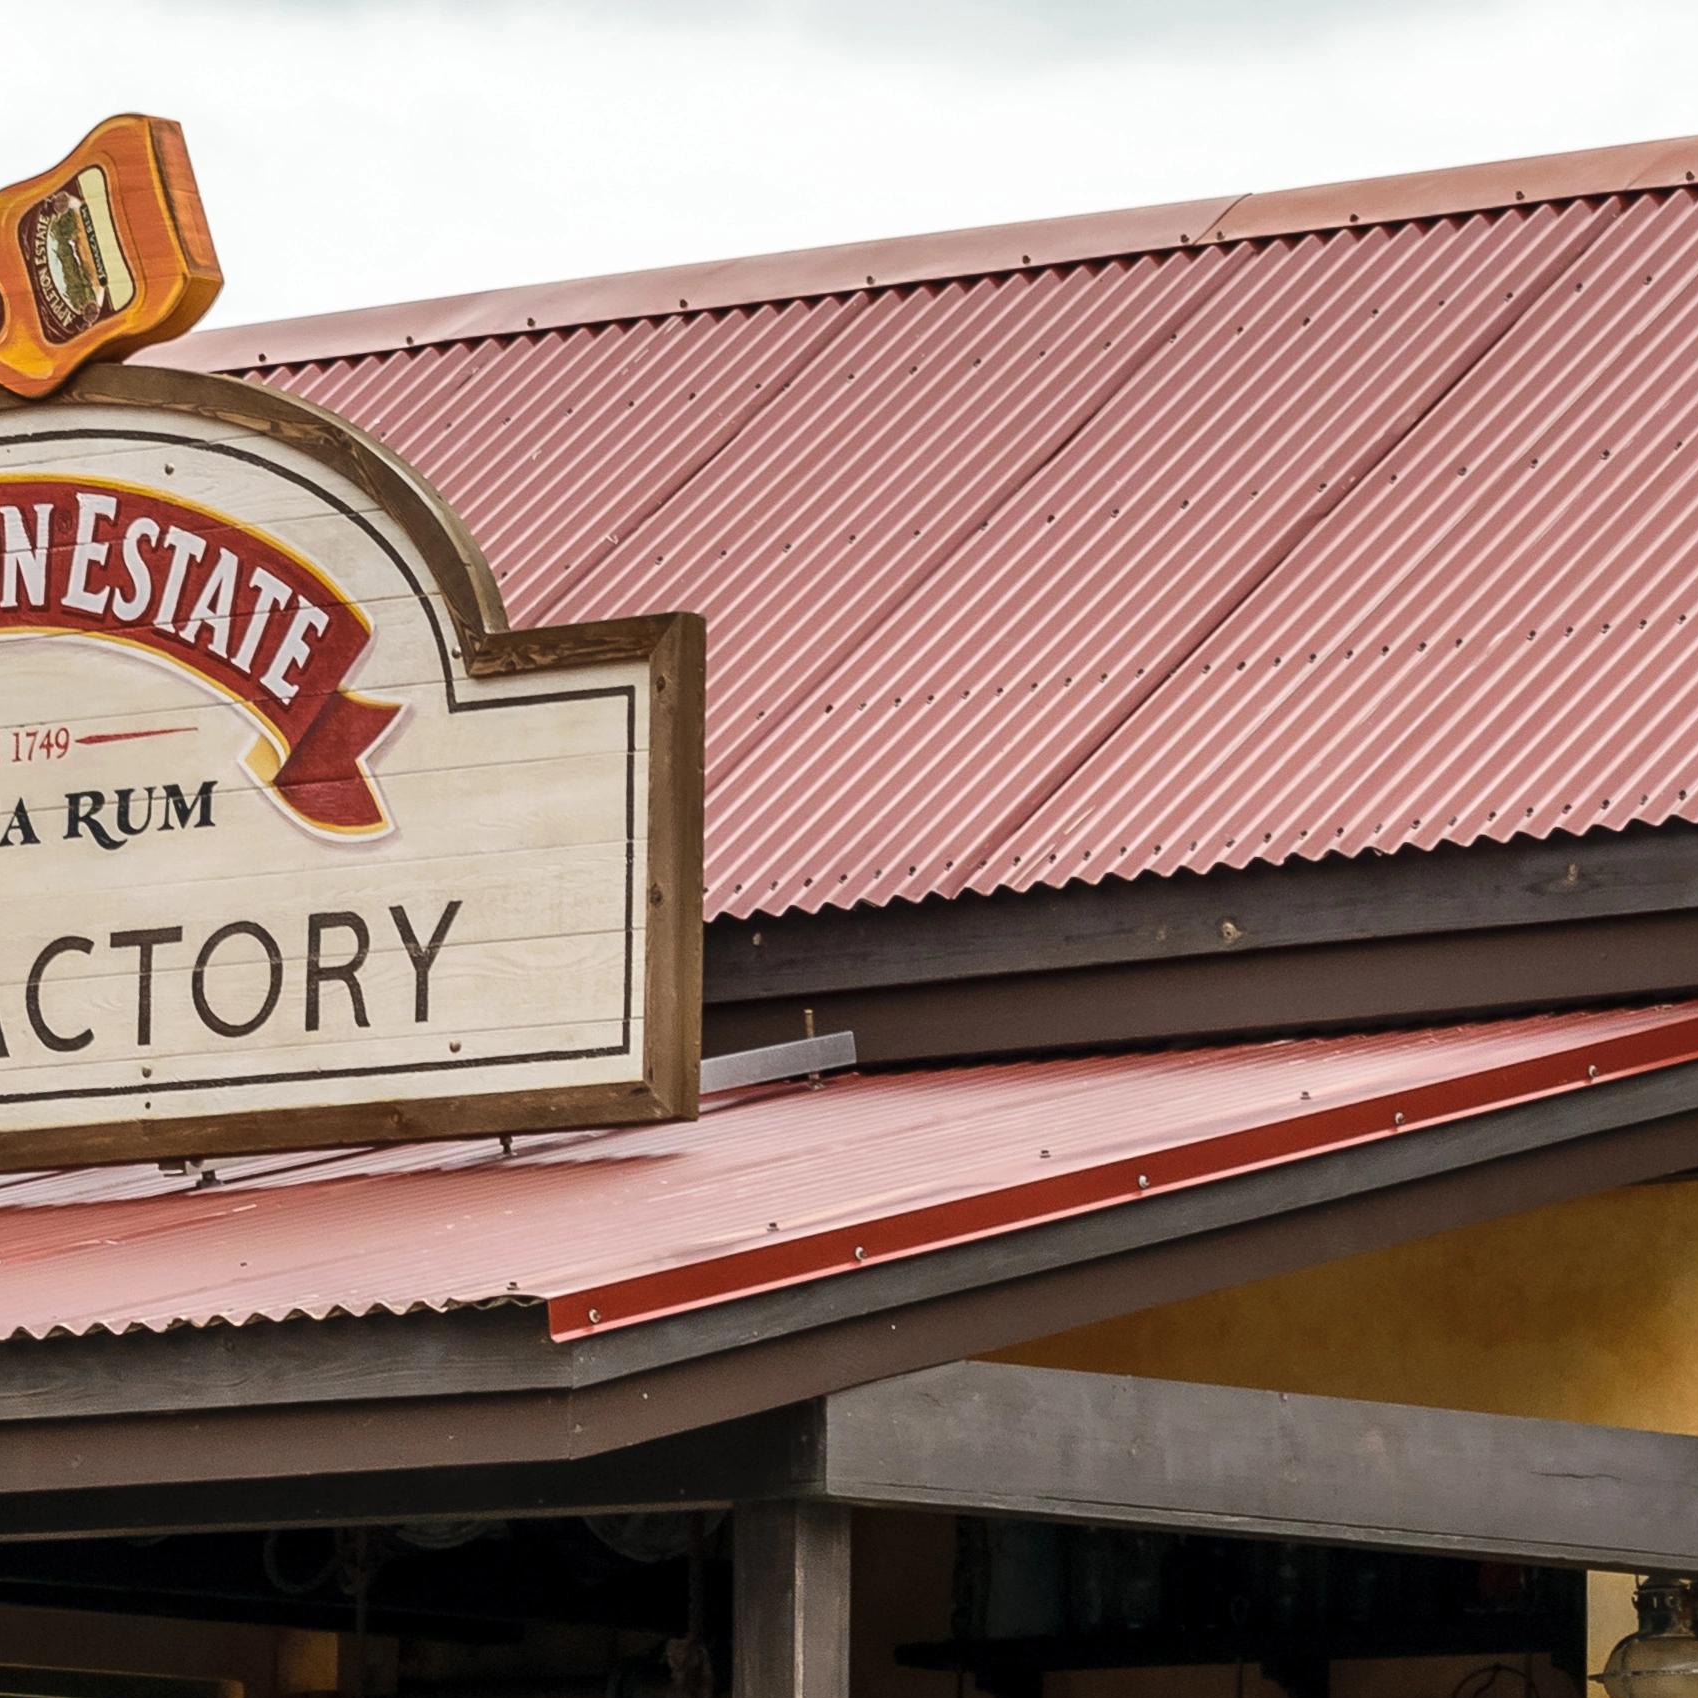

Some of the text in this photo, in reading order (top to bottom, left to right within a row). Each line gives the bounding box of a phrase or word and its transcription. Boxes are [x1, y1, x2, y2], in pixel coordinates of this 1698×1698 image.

[34, 215, 76, 327] APPLETON ESTATE
[61, 492, 329, 706] ESTATE
[12, 727, 70, 762] 1749
[63, 780, 218, 851] RUM
